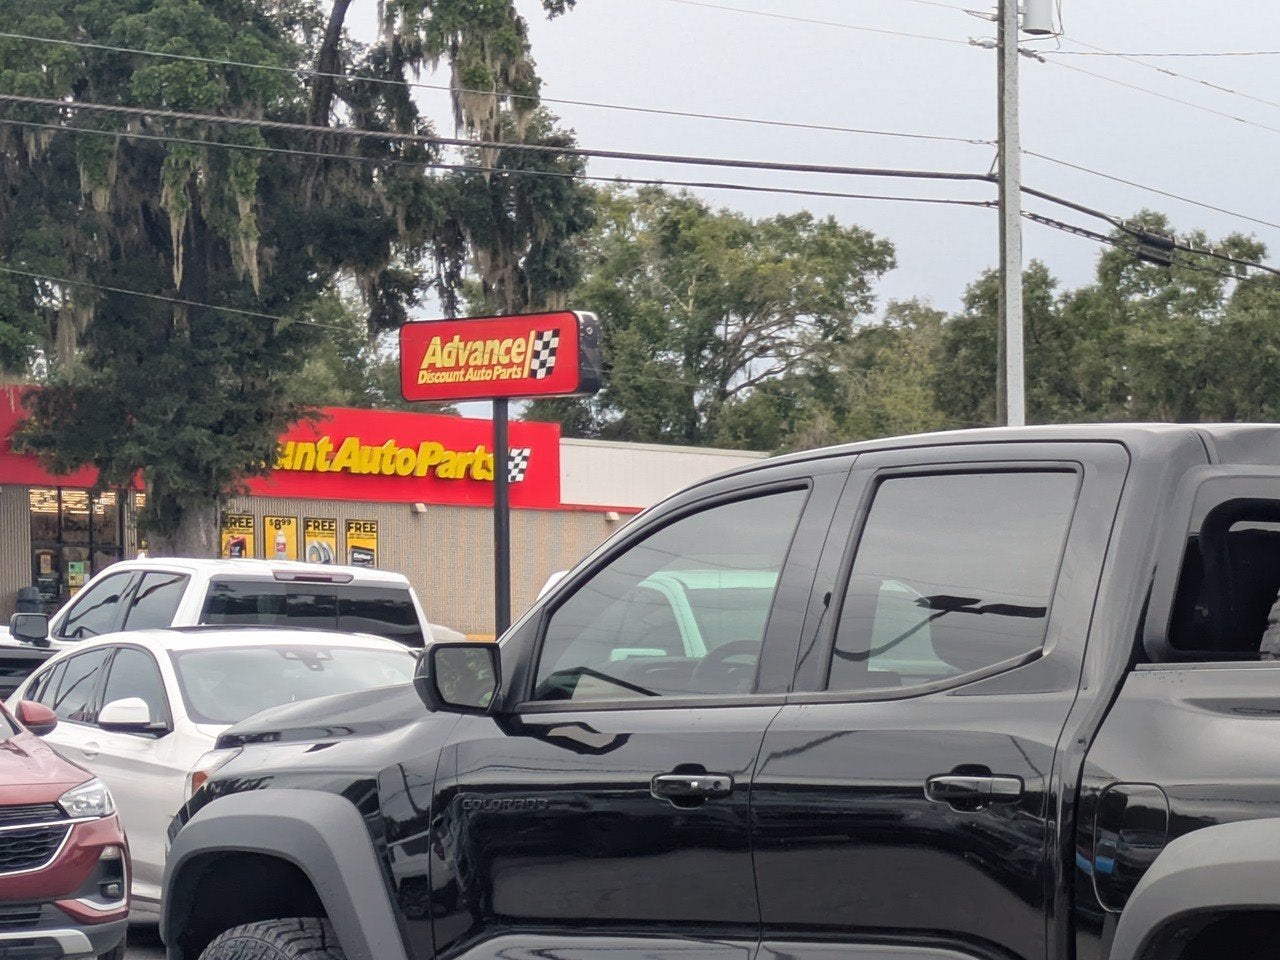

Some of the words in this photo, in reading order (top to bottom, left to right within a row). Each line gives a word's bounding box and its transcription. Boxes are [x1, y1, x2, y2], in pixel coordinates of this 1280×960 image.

[420, 334, 526, 369] Advance
[417, 368, 464, 385] Discount
[465, 366, 492, 382] Auto
[493, 364, 523, 381] Parts
[330, 436, 416, 476] Auto
[305, 519, 335, 532] FREE
[347, 521, 376, 534] FREE
